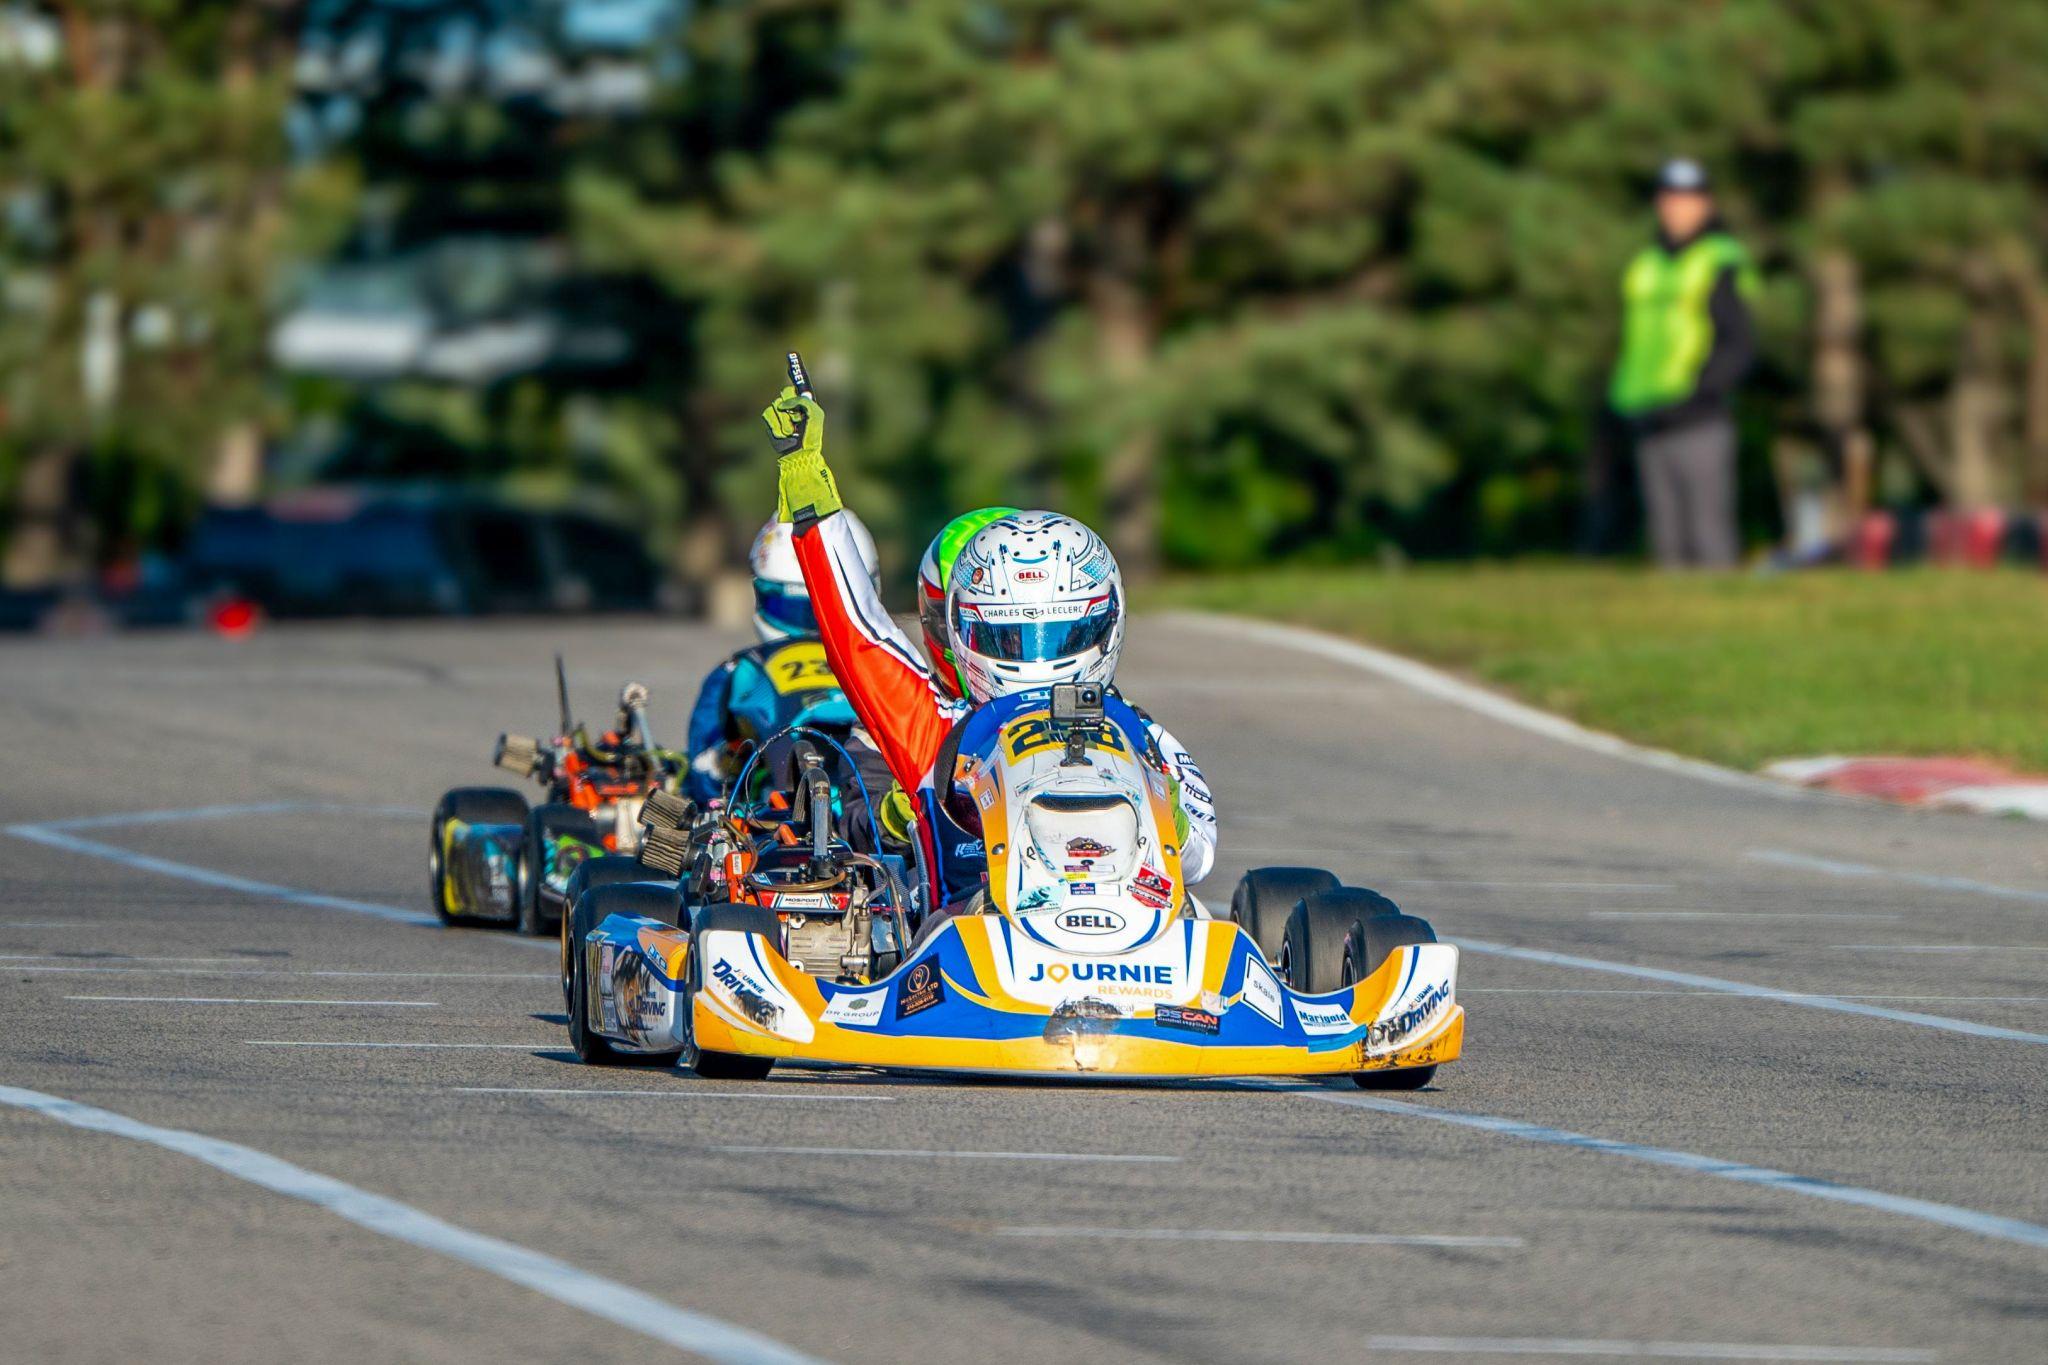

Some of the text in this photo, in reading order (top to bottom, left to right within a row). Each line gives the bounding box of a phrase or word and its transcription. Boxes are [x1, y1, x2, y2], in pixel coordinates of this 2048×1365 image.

[789, 352, 805, 385] OFFSET
[1018, 571, 1045, 580] BELL
[983, 609, 1020, 618] CHARLES
[1047, 606, 1084, 615] LECLERC
[1066, 915, 1117, 928] BELL
[734, 968, 765, 994] JOURNIE
[1029, 963, 1173, 985] JOURNIE
[1097, 985, 1174, 1000] REWARDS
[1399, 979, 1449, 1033] DRIVING
[843, 1010, 880, 1018] GROUP
[1299, 1010, 1348, 1024] Marigold
